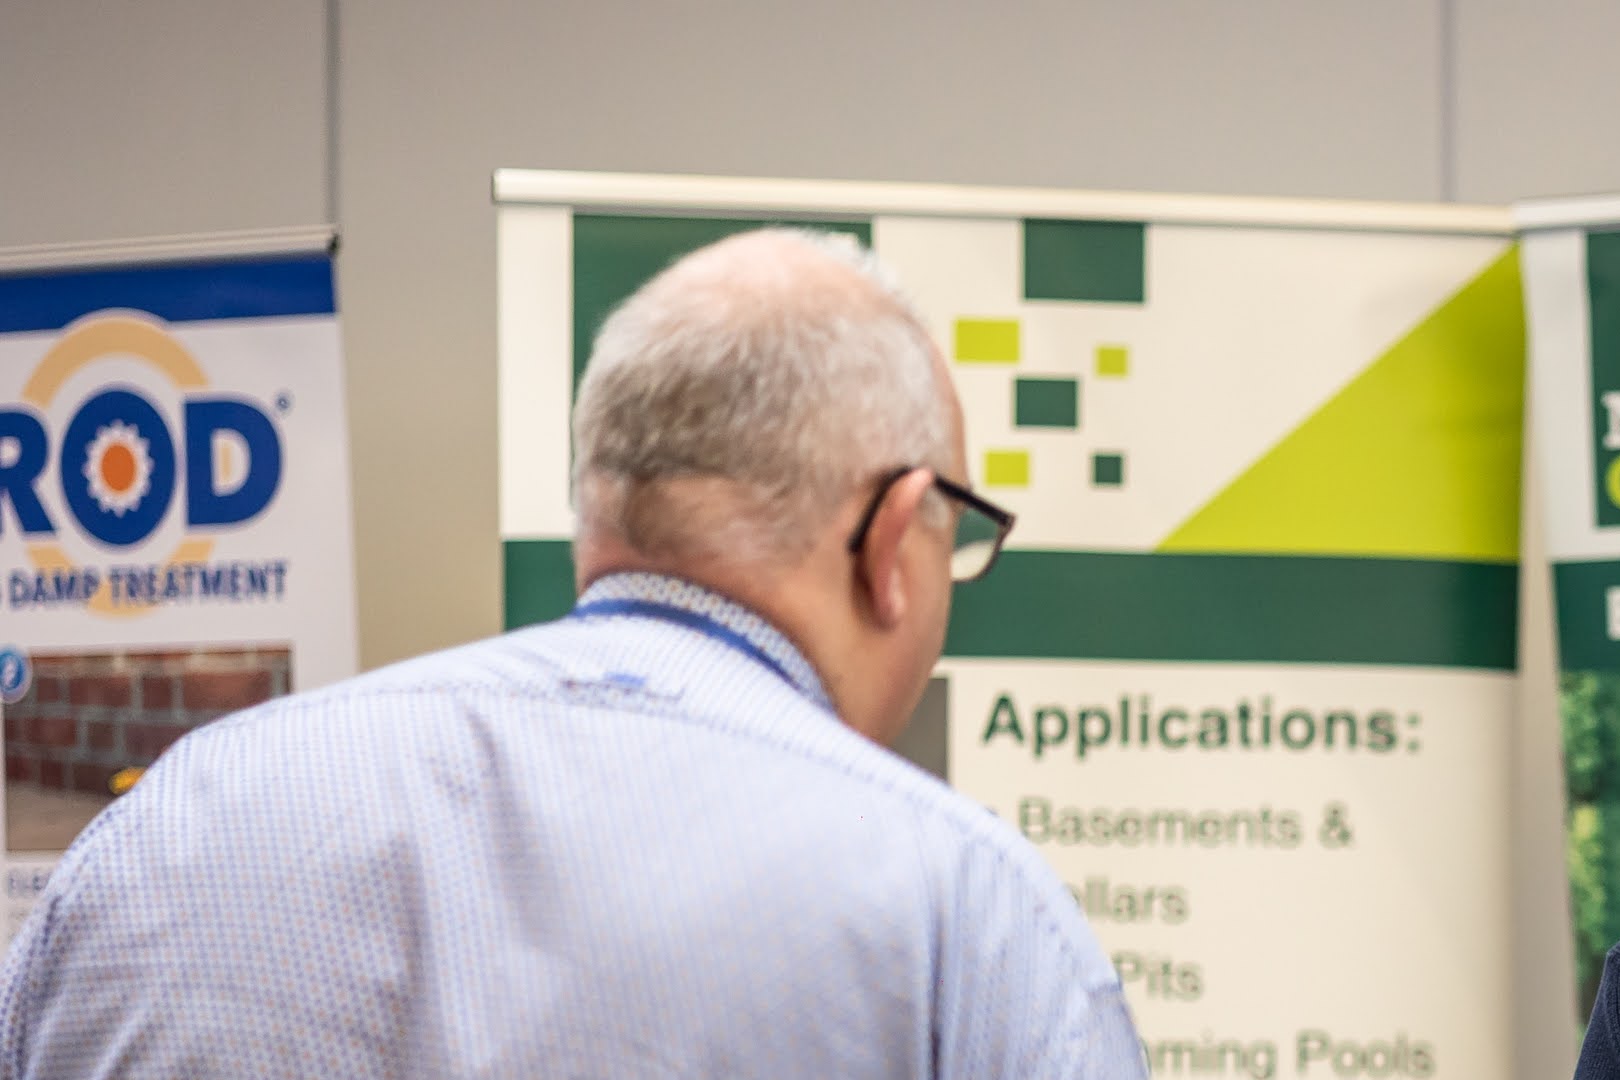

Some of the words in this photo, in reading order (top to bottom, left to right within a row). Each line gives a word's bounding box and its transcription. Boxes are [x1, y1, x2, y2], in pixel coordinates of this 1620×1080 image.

[8, 567, 99, 609] DAMP
[109, 559, 287, 605] TREATMENT
[982, 692, 1422, 758] Applications:
[1018, 796, 1303, 848] Basements
[1319, 801, 1353, 849] &
[1295, 1028, 1437, 1080] Pools
